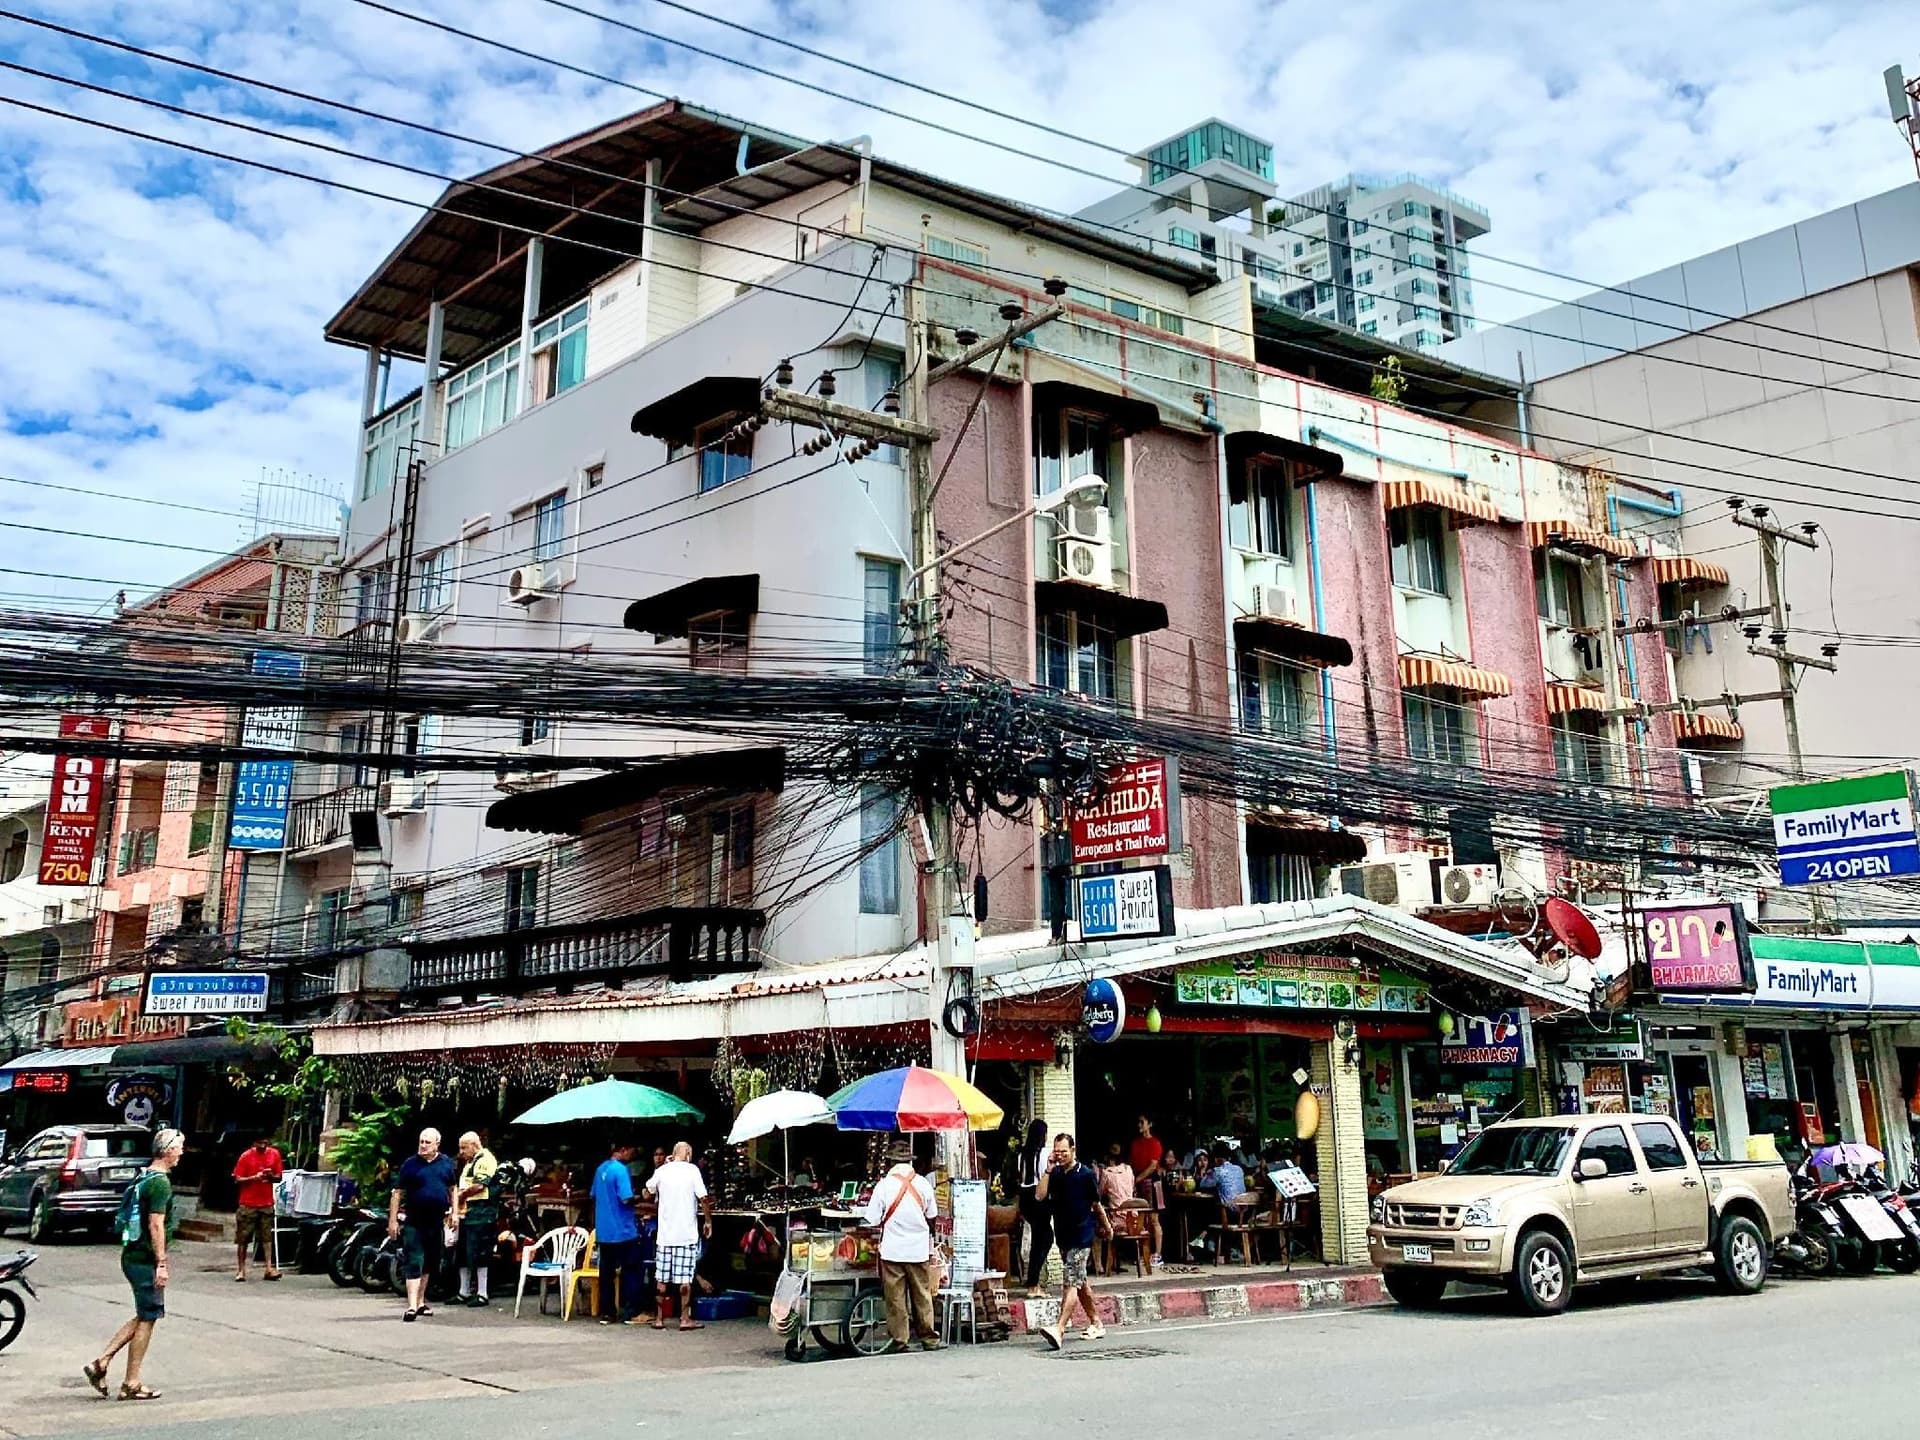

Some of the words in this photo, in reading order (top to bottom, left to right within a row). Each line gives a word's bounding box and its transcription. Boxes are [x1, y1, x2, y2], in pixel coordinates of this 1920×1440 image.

[49, 825, 95, 837] RENT
[1087, 814, 1151, 839] Restaurant
[1784, 808, 1901, 838] FamilyMart
[1074, 842, 1113, 858] European
[1114, 839, 1123, 852] &
[1124, 836, 1142, 850] Thai
[1143, 833, 1166, 848] Food
[1807, 863, 1833, 880] 24
[1834, 855, 1890, 877] OPEN
[1119, 875, 1153, 898] Sweet
[1121, 898, 1154, 920] Pound
[1648, 915, 1711, 960] ยา
[1652, 962, 1739, 986] PHARMACY
[1767, 965, 1857, 998] FamilyMart
[152, 996, 187, 1010] Sweet
[193, 996, 227, 1009] Pound
[233, 995, 262, 1009] Hotel
[1441, 1047, 1519, 1063] PHARMACY
[1621, 1049, 1638, 1059] ATM
